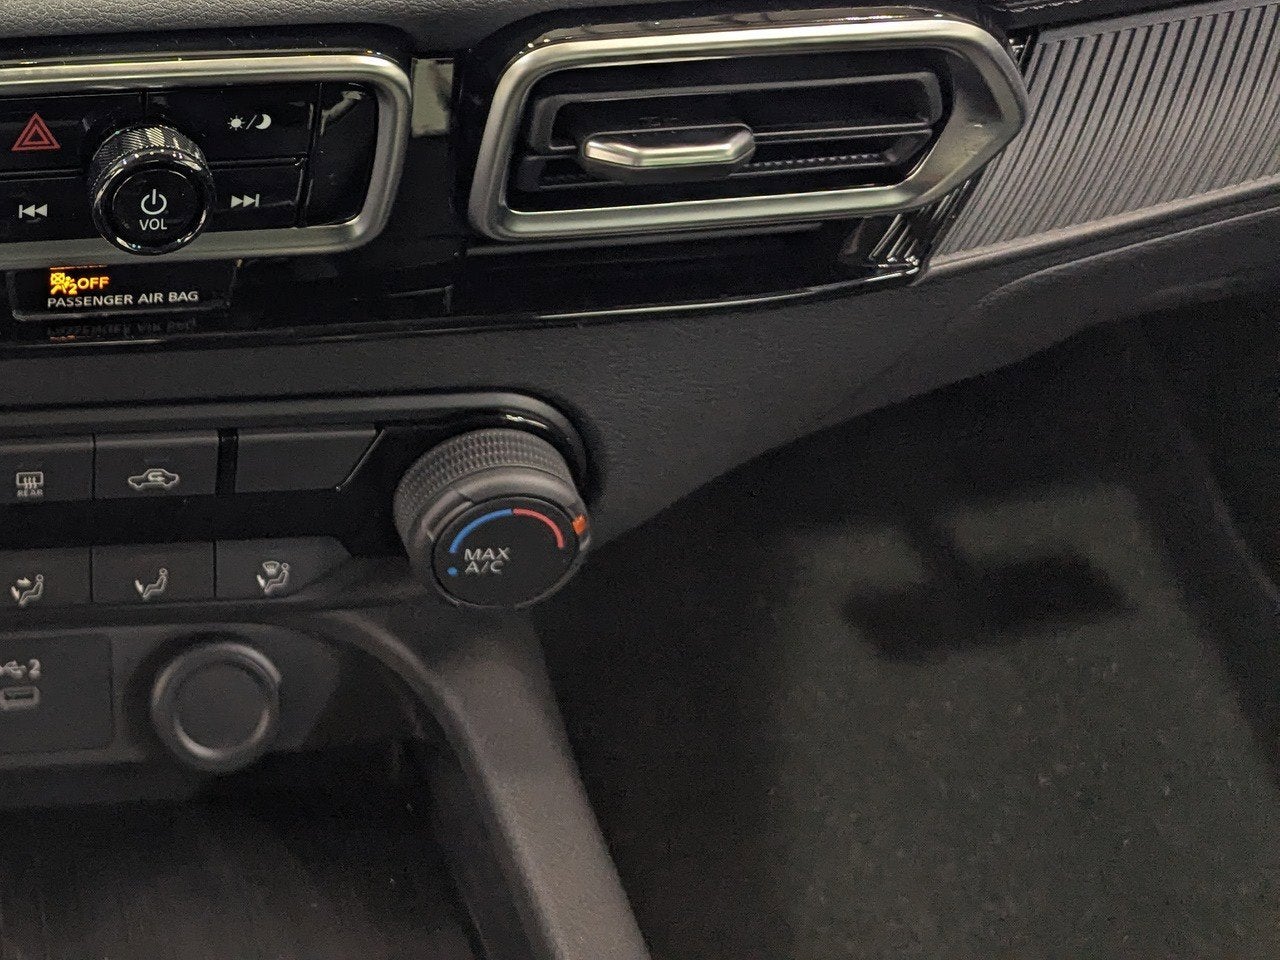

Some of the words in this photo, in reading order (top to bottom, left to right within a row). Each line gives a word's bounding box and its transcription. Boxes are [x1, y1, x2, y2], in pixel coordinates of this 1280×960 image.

[138, 218, 168, 231] VOL
[77, 276, 110, 290] OFF
[47, 293, 133, 309] PASSENGER
[137, 292, 164, 305] AIR
[168, 290, 199, 303] BAG
[16, 488, 44, 498] REAR
[463, 547, 511, 561] MAX
[463, 560, 505, 575] A/C
[28, 659, 41, 680] 2
